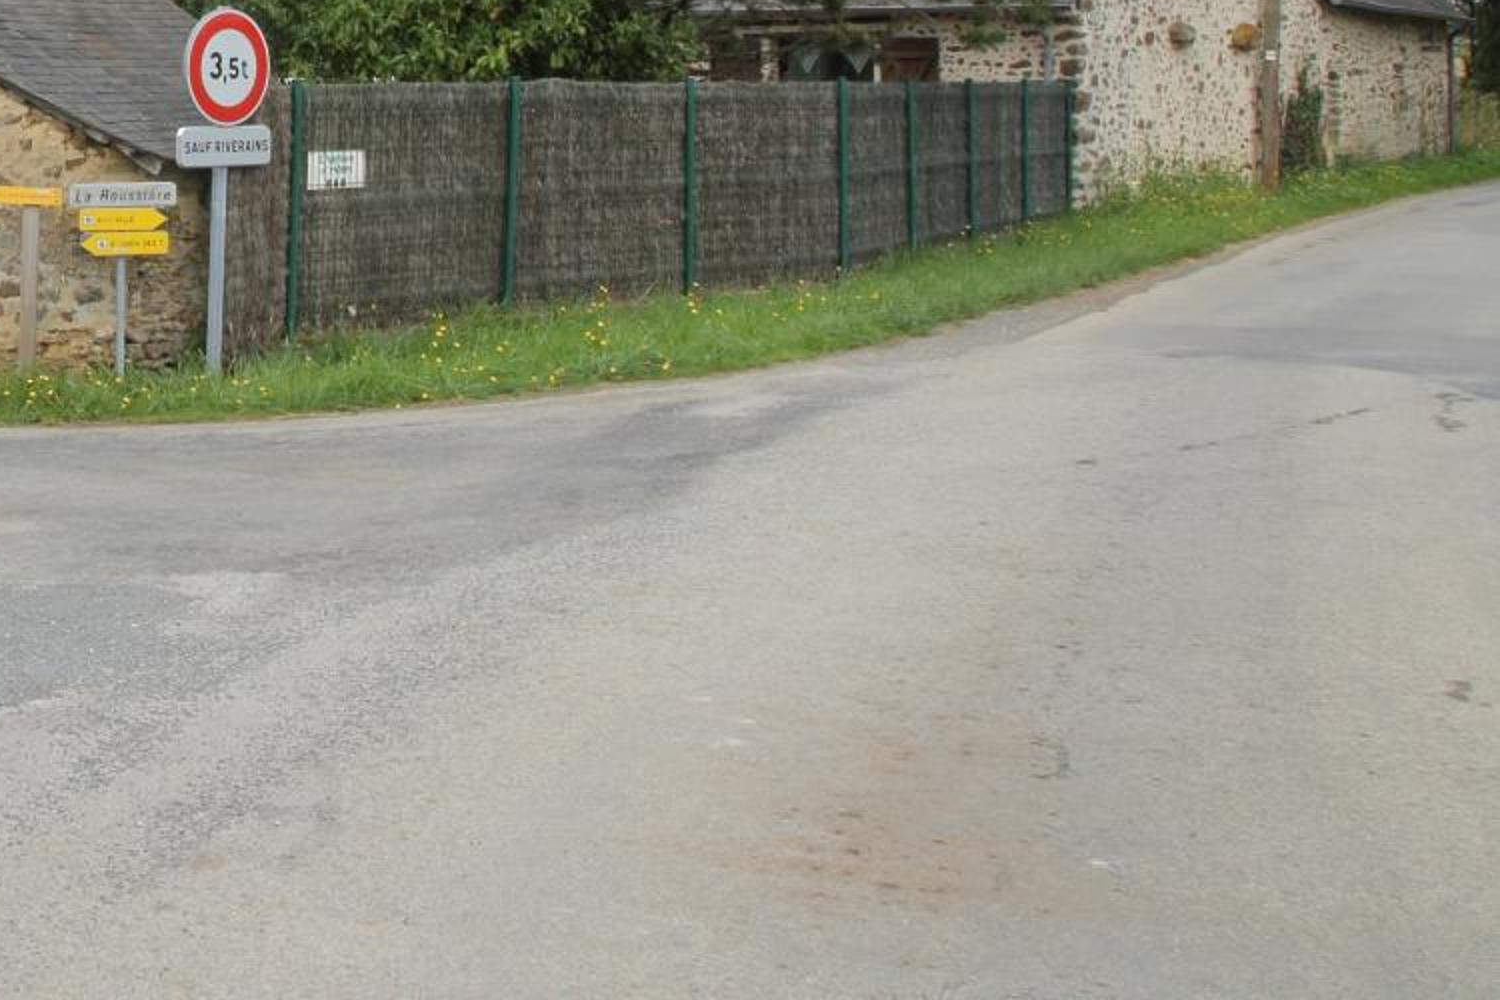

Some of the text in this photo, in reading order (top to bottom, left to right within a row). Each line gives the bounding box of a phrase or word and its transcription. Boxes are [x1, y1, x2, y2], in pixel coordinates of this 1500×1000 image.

[184, 139, 269, 155] SAUF RIVERAINS
[75, 187, 92, 203] La
